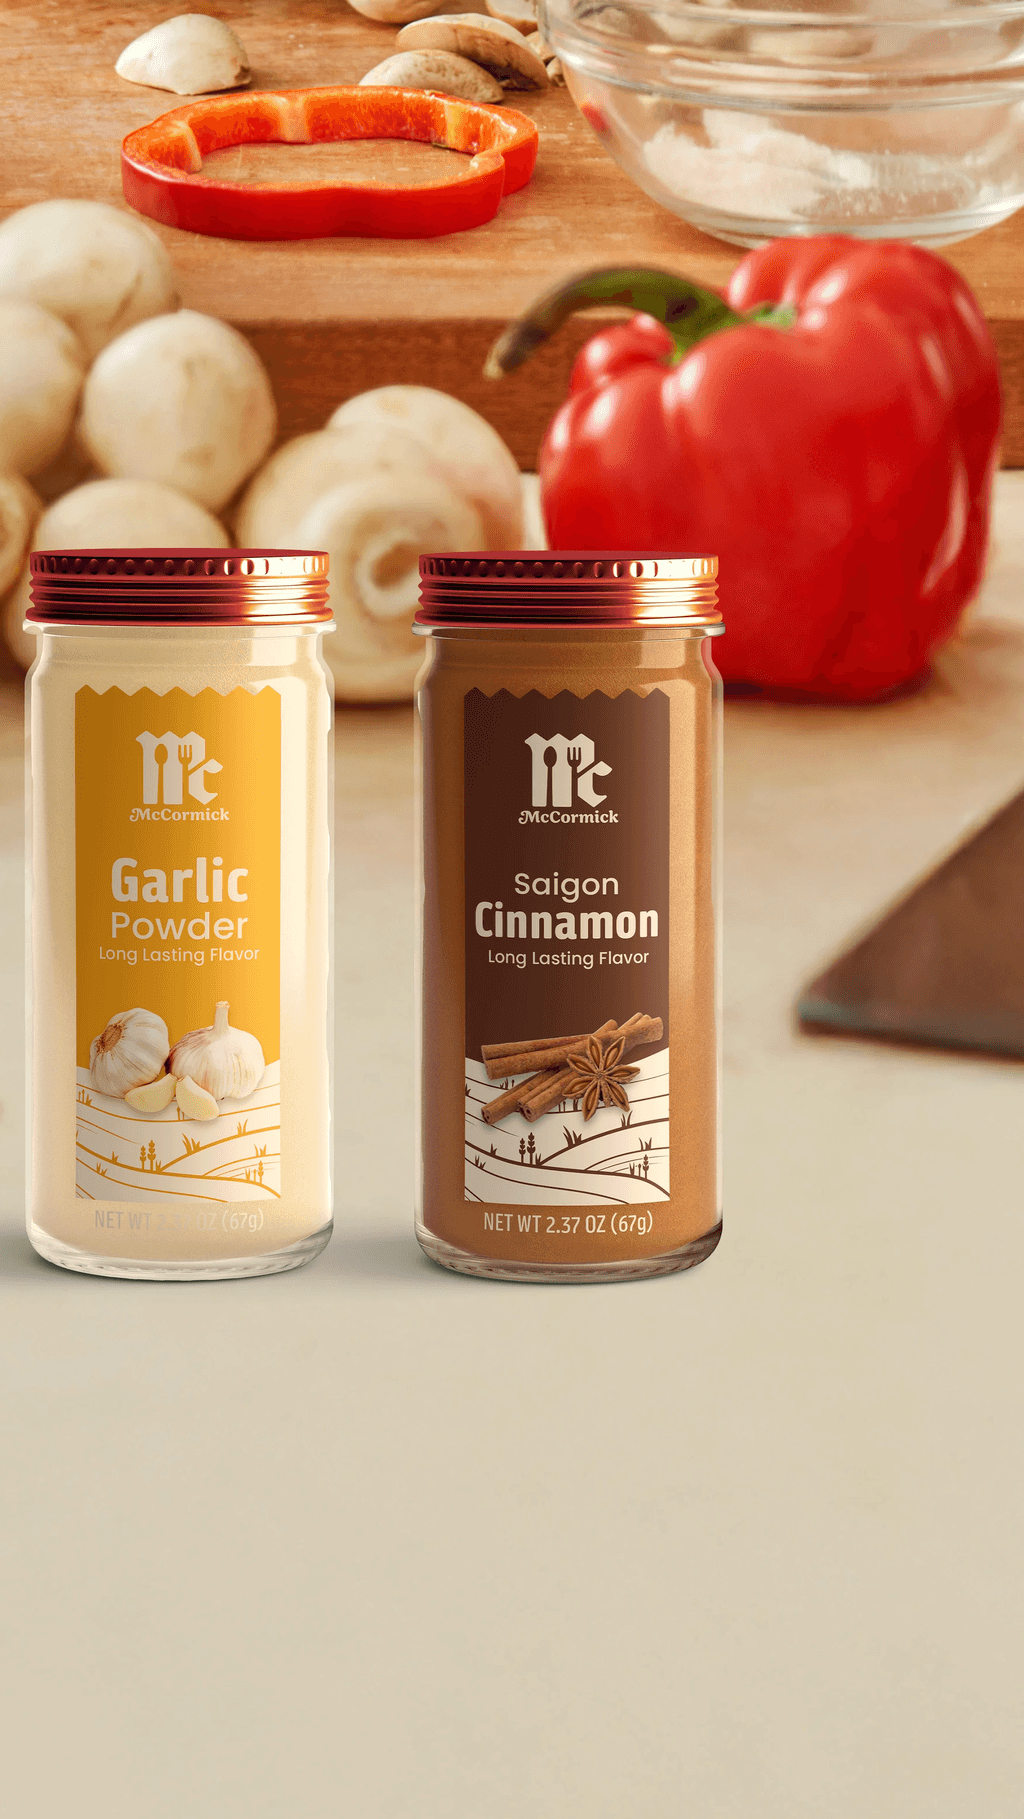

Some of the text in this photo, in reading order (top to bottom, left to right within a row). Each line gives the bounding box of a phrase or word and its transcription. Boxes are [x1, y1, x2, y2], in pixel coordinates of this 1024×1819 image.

[129, 808, 230, 822] McCormick
[518, 810, 619, 824] McCormick
[111, 857, 249, 903] Garlic
[514, 872, 619, 903] Saigon
[111, 911, 248, 940] Powder
[475, 901, 658, 940] Cinnamon
[99, 946, 260, 966] Long Lasting Flavor
[488, 950, 650, 970] Long Lasting Flavor
[95, 1208, 264, 1232] NET WT 2.37 OZ (67g)
[484, 1210, 653, 1235] NET WT 2.37 OZ (67g)
